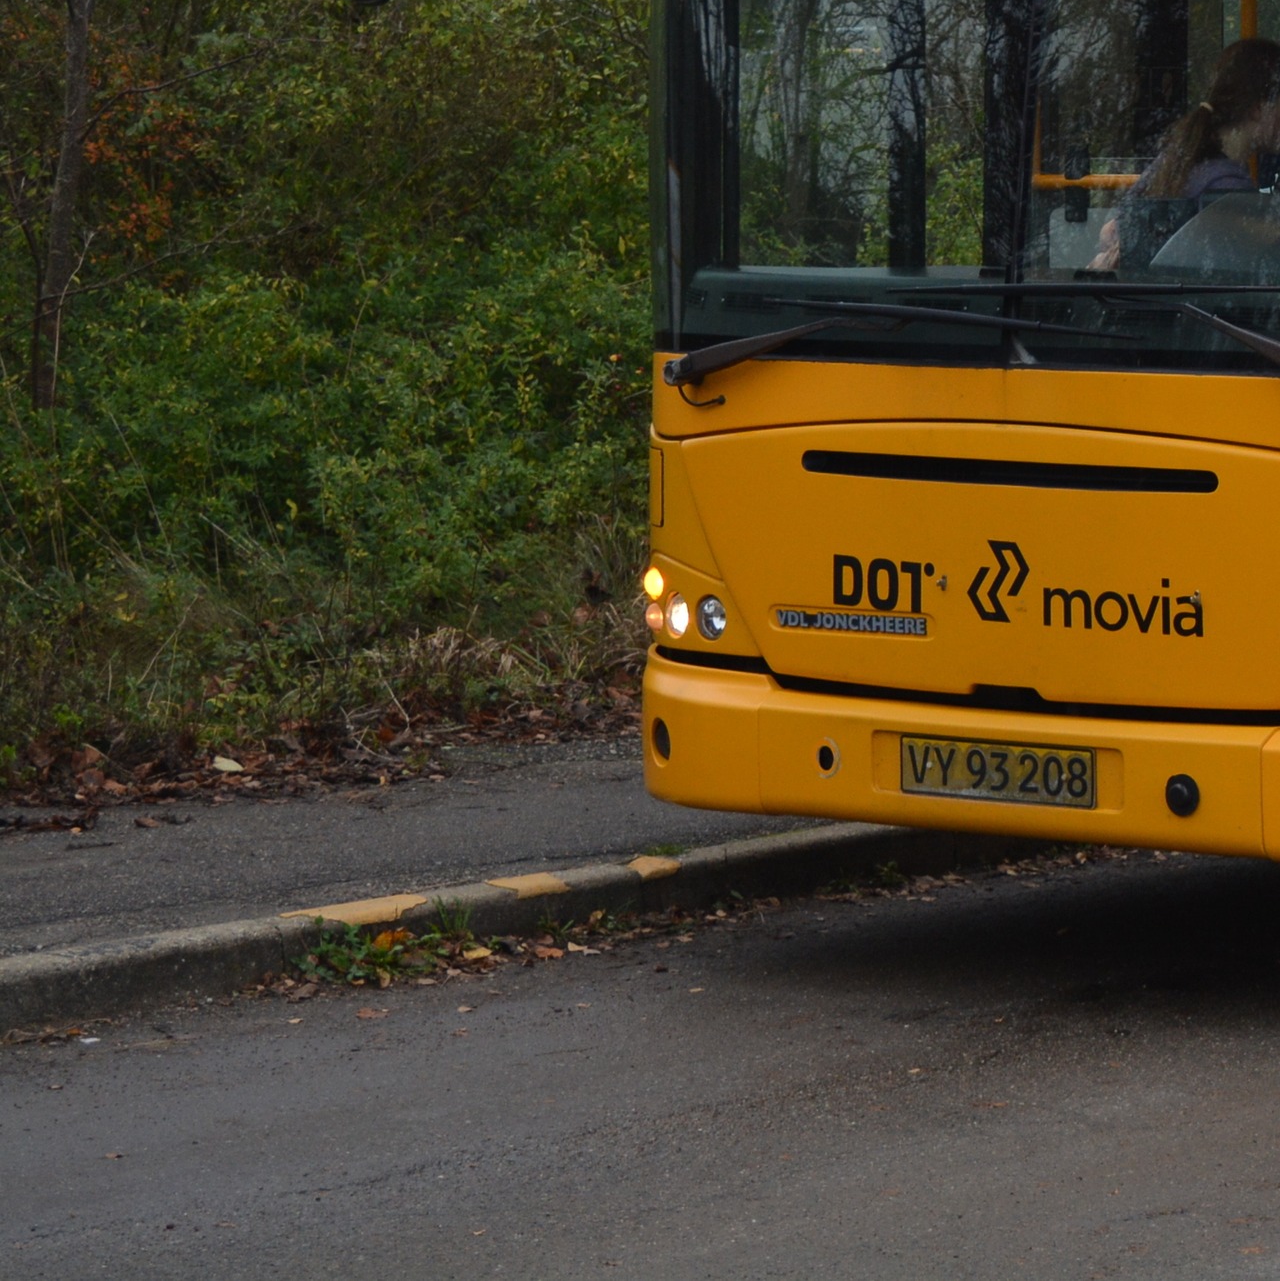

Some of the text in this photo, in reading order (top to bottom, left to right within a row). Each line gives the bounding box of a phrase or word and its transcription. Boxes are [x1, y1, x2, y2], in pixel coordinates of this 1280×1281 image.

[776, 609, 927, 635] VDL JONCKHEERE
[1043, 578, 1204, 637] movia
[908, 745, 1088, 798] VY 93 208
